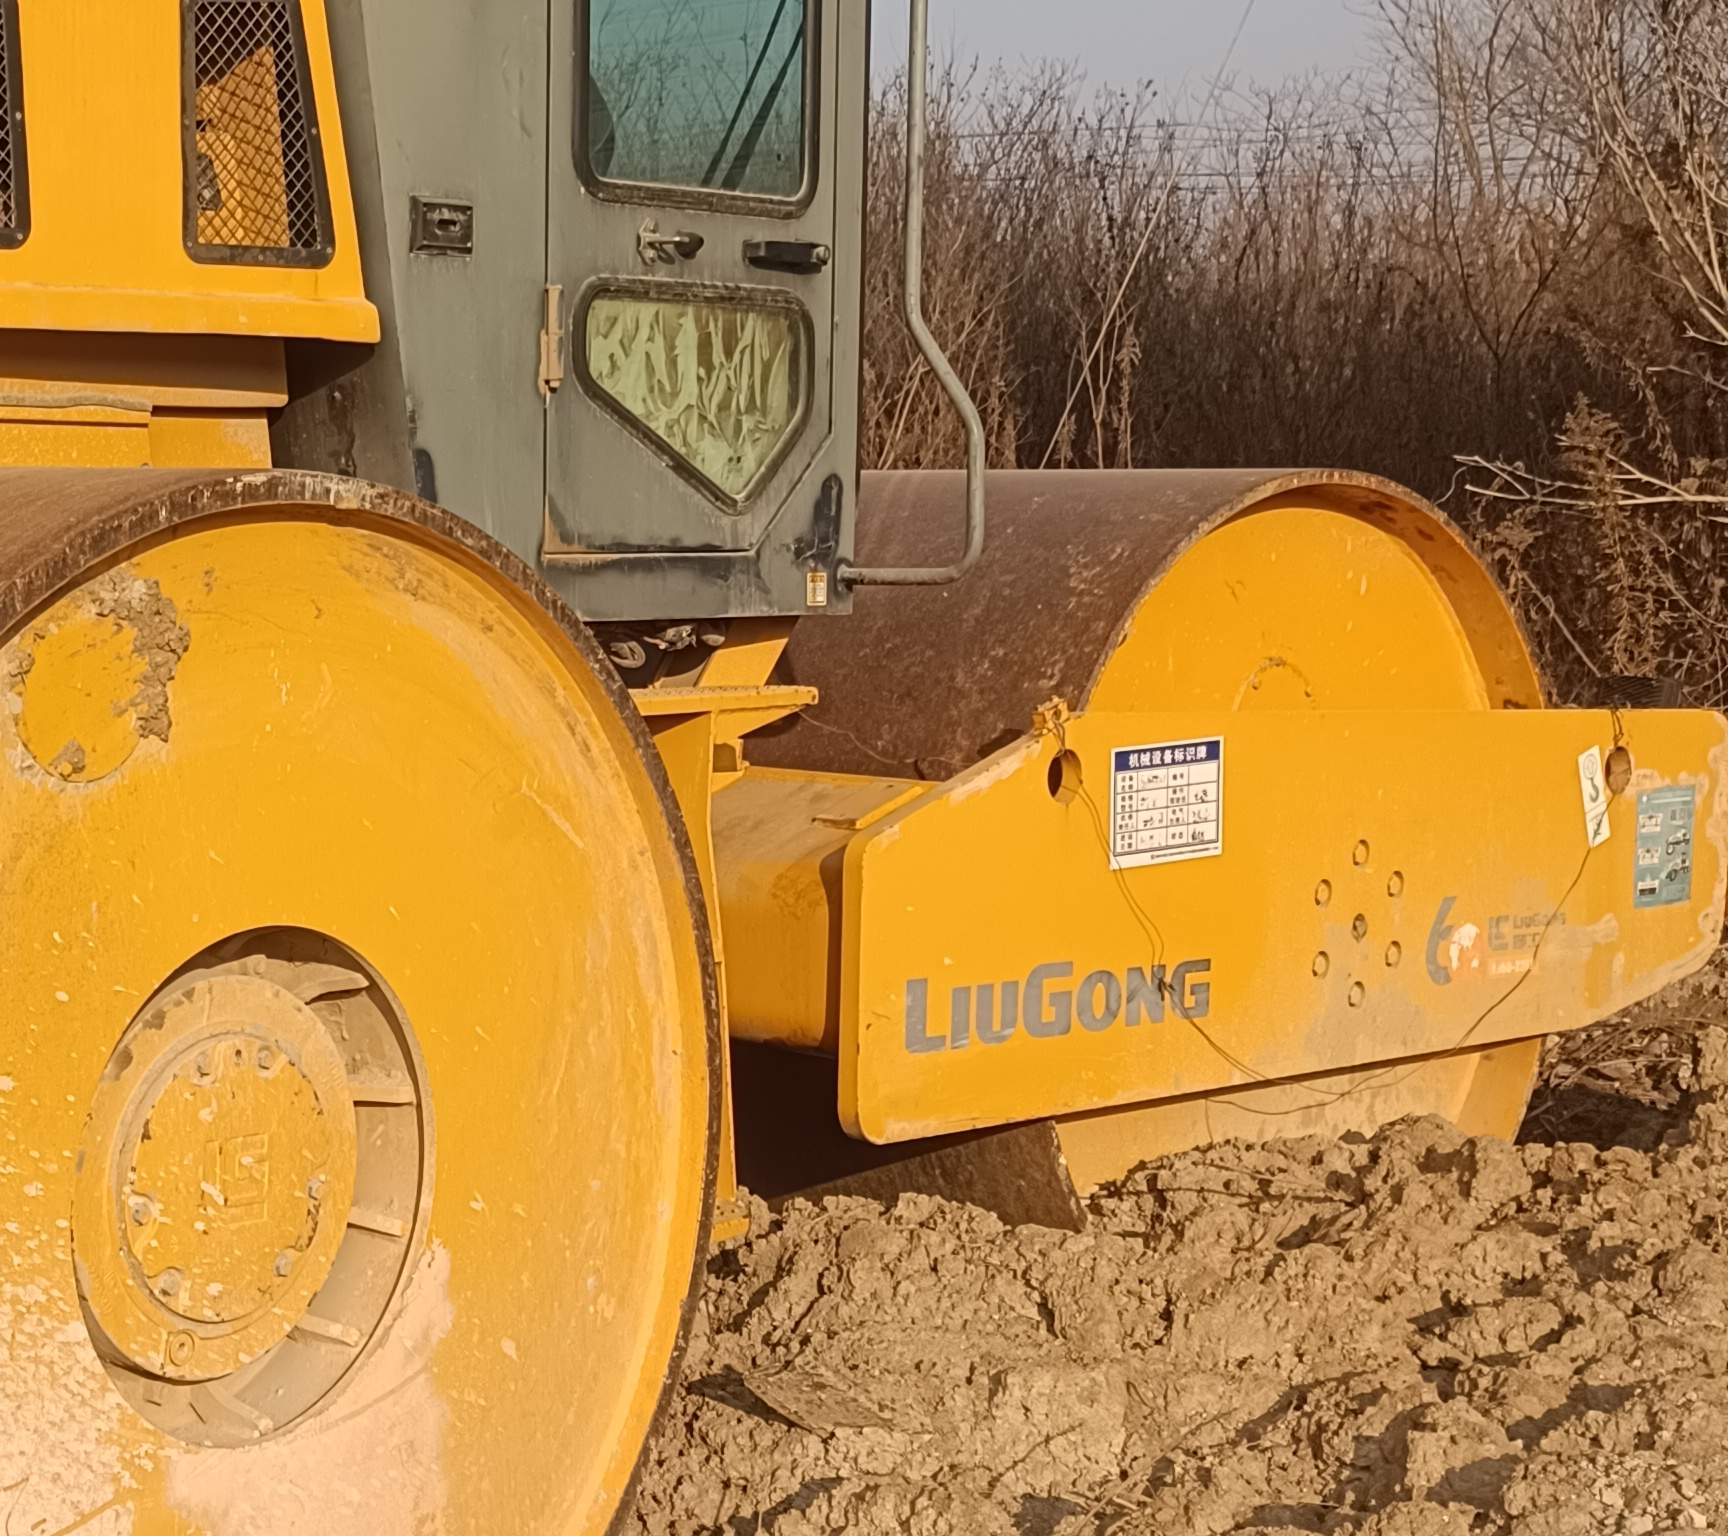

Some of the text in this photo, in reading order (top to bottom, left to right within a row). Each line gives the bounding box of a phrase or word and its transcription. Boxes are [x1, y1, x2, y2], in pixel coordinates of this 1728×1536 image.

[1128, 745, 1207, 769] 机械设备标识牌
